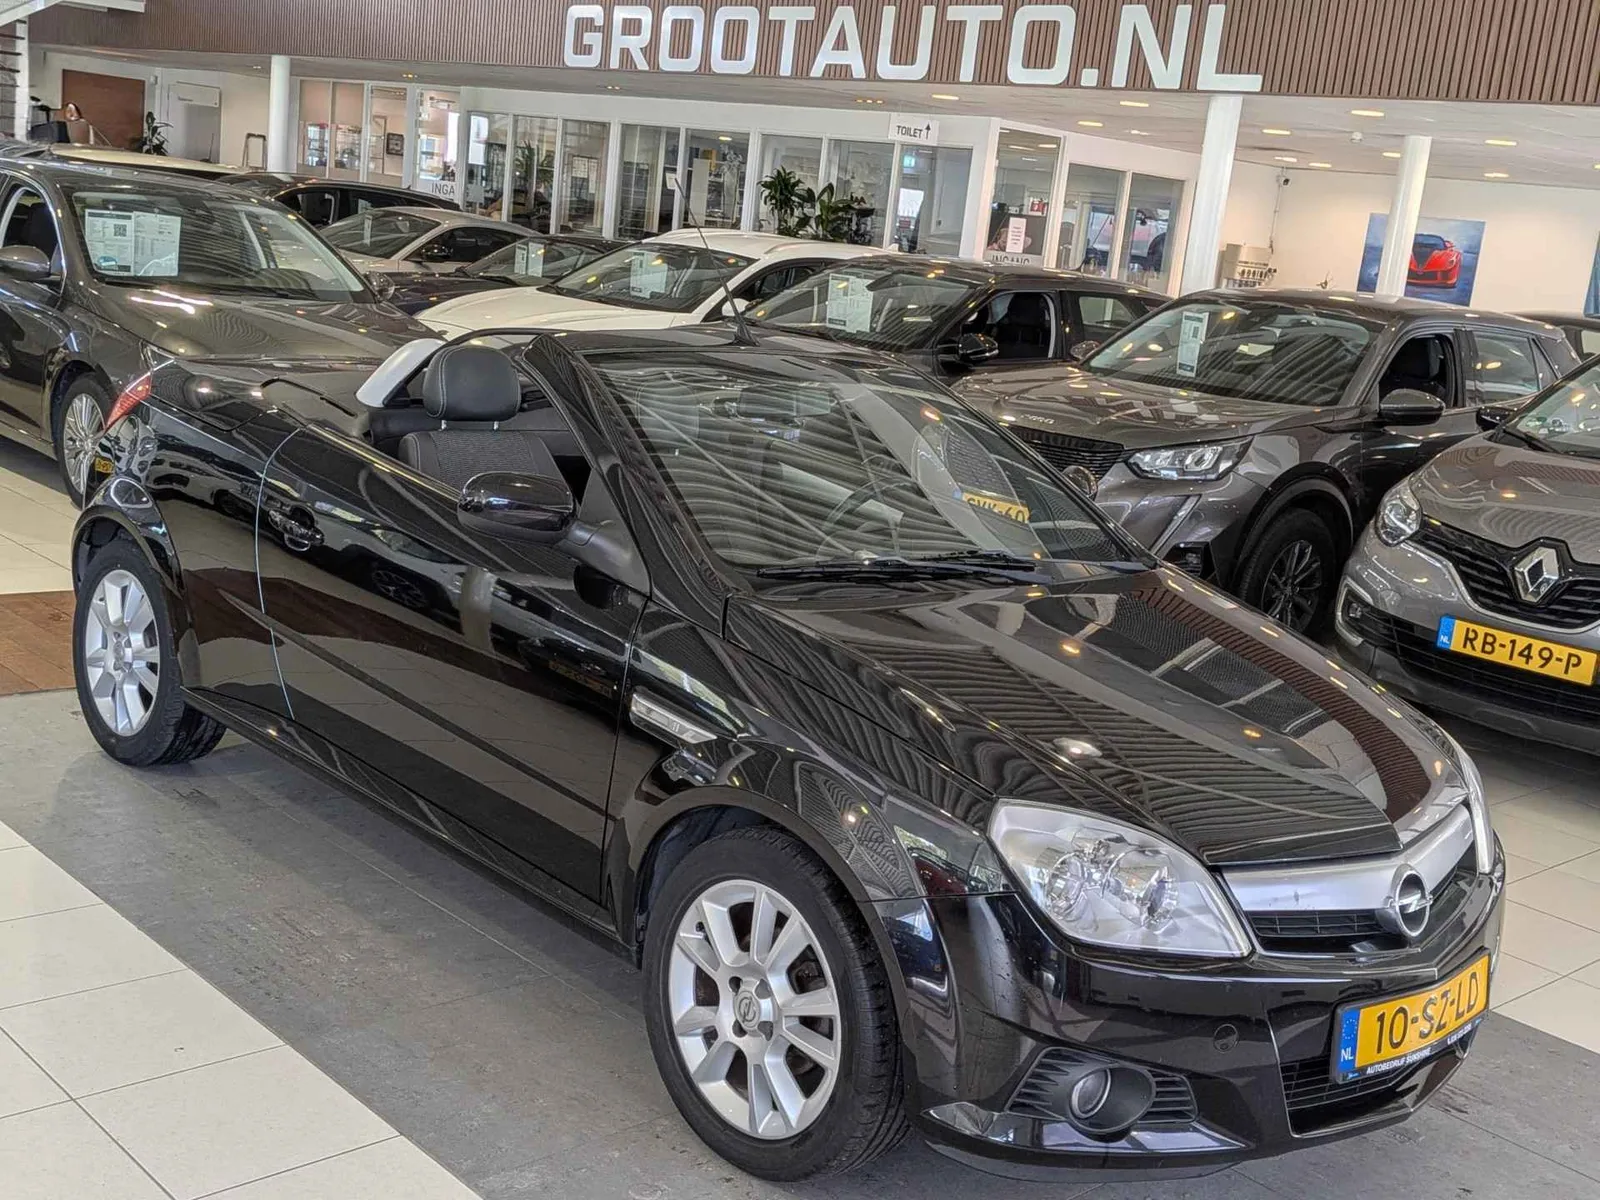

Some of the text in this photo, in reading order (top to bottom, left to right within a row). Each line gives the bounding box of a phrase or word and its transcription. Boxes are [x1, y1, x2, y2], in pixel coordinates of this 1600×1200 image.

[563, 4, 1263, 92] GROOTAUTO.NL
[896, 125, 923, 139] TOILET
[1440, 634, 1450, 644] NL
[1462, 627, 1582, 675] RB-149-P
[1376, 971, 1479, 1055] 10-SZ-LD
[1340, 1047, 1354, 1062] NL
